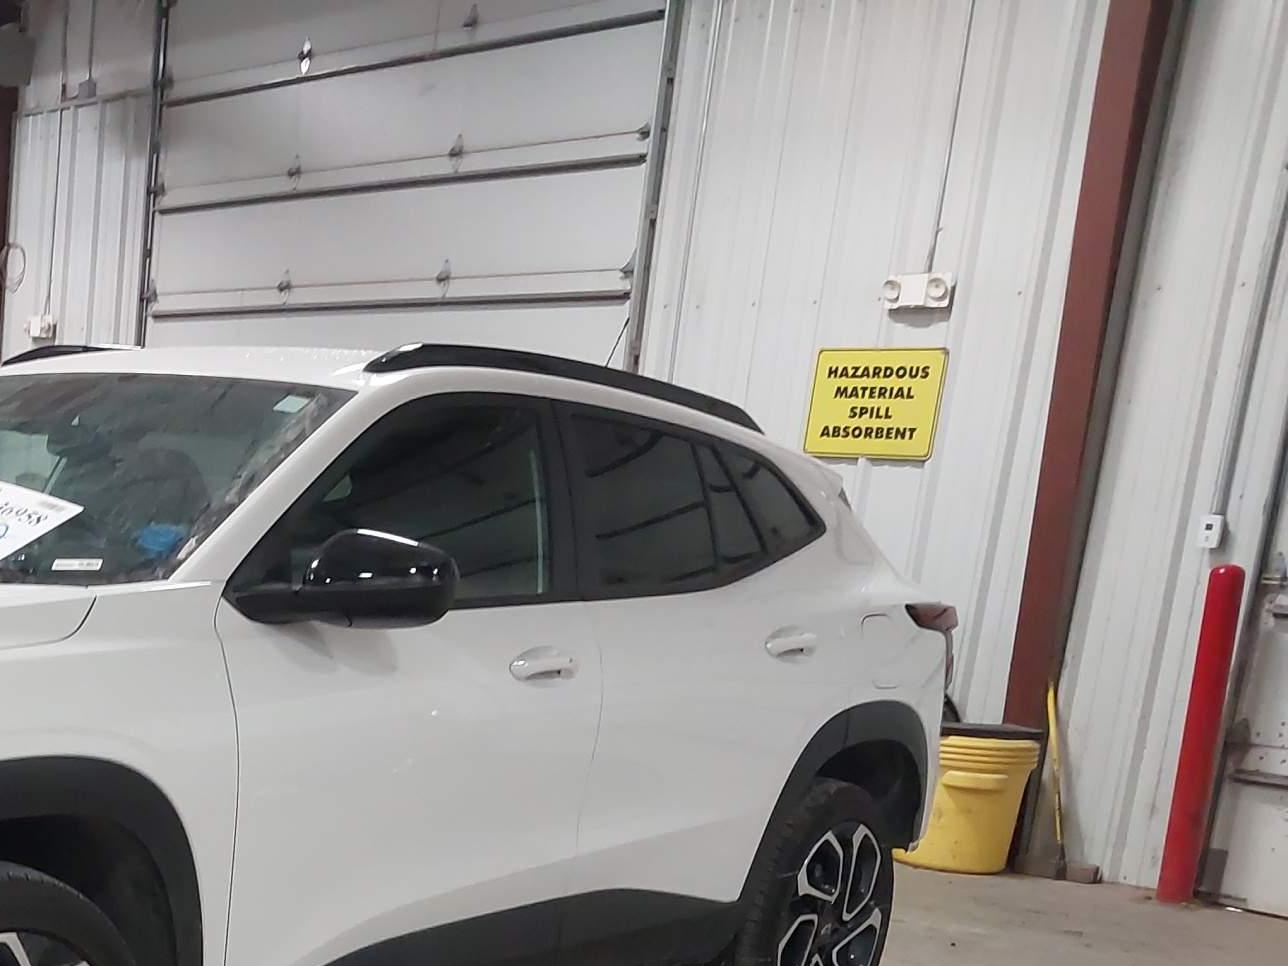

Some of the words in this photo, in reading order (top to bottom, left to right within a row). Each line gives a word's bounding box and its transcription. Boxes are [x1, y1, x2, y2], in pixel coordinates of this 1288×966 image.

[827, 365, 930, 379] HAZARDOUS
[833, 386, 915, 400] MATERIAL
[848, 406, 893, 420] SPILL
[819, 425, 918, 441] ABSORBENT
